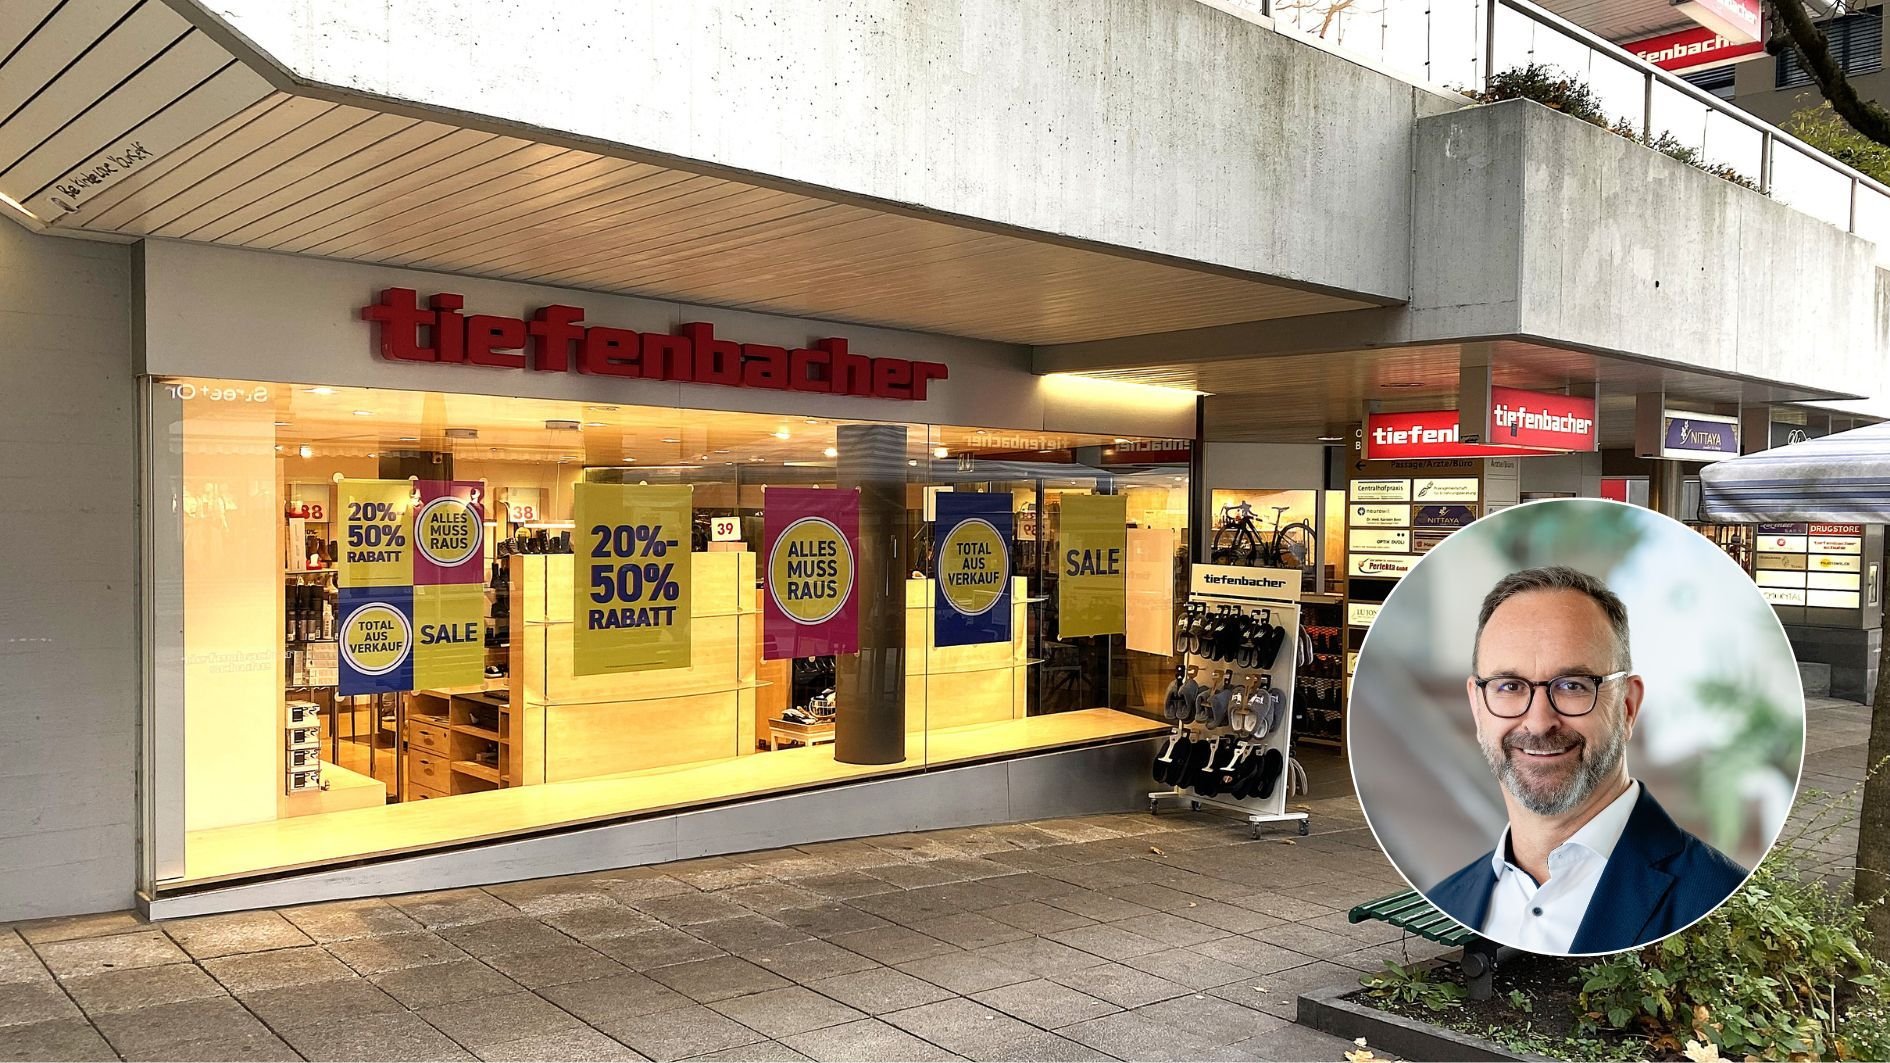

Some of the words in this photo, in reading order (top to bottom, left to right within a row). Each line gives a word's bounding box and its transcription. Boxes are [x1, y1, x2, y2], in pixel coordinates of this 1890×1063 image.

[361, 287, 948, 401] tiefenbacher
[1494, 403, 1592, 435] tiefenbacher
[1691, 430, 1722, 446] NITTAYA
[1358, 485, 1403, 493] Centralhofpraxis
[431, 512, 467, 524] ALLES
[513, 506, 533, 519] 38
[348, 524, 406, 547] 50%
[430, 524, 468, 536] MUSS
[717, 523, 733, 535] 39
[1811, 525, 1860, 533] DRUGSTORE
[430, 537, 468, 549] RAUS
[590, 524, 679, 558] 20%-
[787, 540, 837, 558] ALLES
[956, 542, 992, 556] TOTAL
[347, 550, 402, 563] RABATT
[962, 557, 985, 570] AUS
[1066, 548, 1120, 576] SALE
[787, 560, 838, 579] MUSS
[1369, 562, 1395, 571] Perfekta
[589, 562, 680, 604] 50%
[948, 571, 1000, 586] VERKAUF
[1204, 574, 1286, 588] tiefenbacher
[787, 580, 838, 600] RAUS
[588, 606, 677, 630] RABATT
[358, 620, 394, 631] TOTAL
[364, 631, 388, 642] AUS
[420, 622, 478, 645] SALE
[349, 641, 403, 654] VERKAUF
